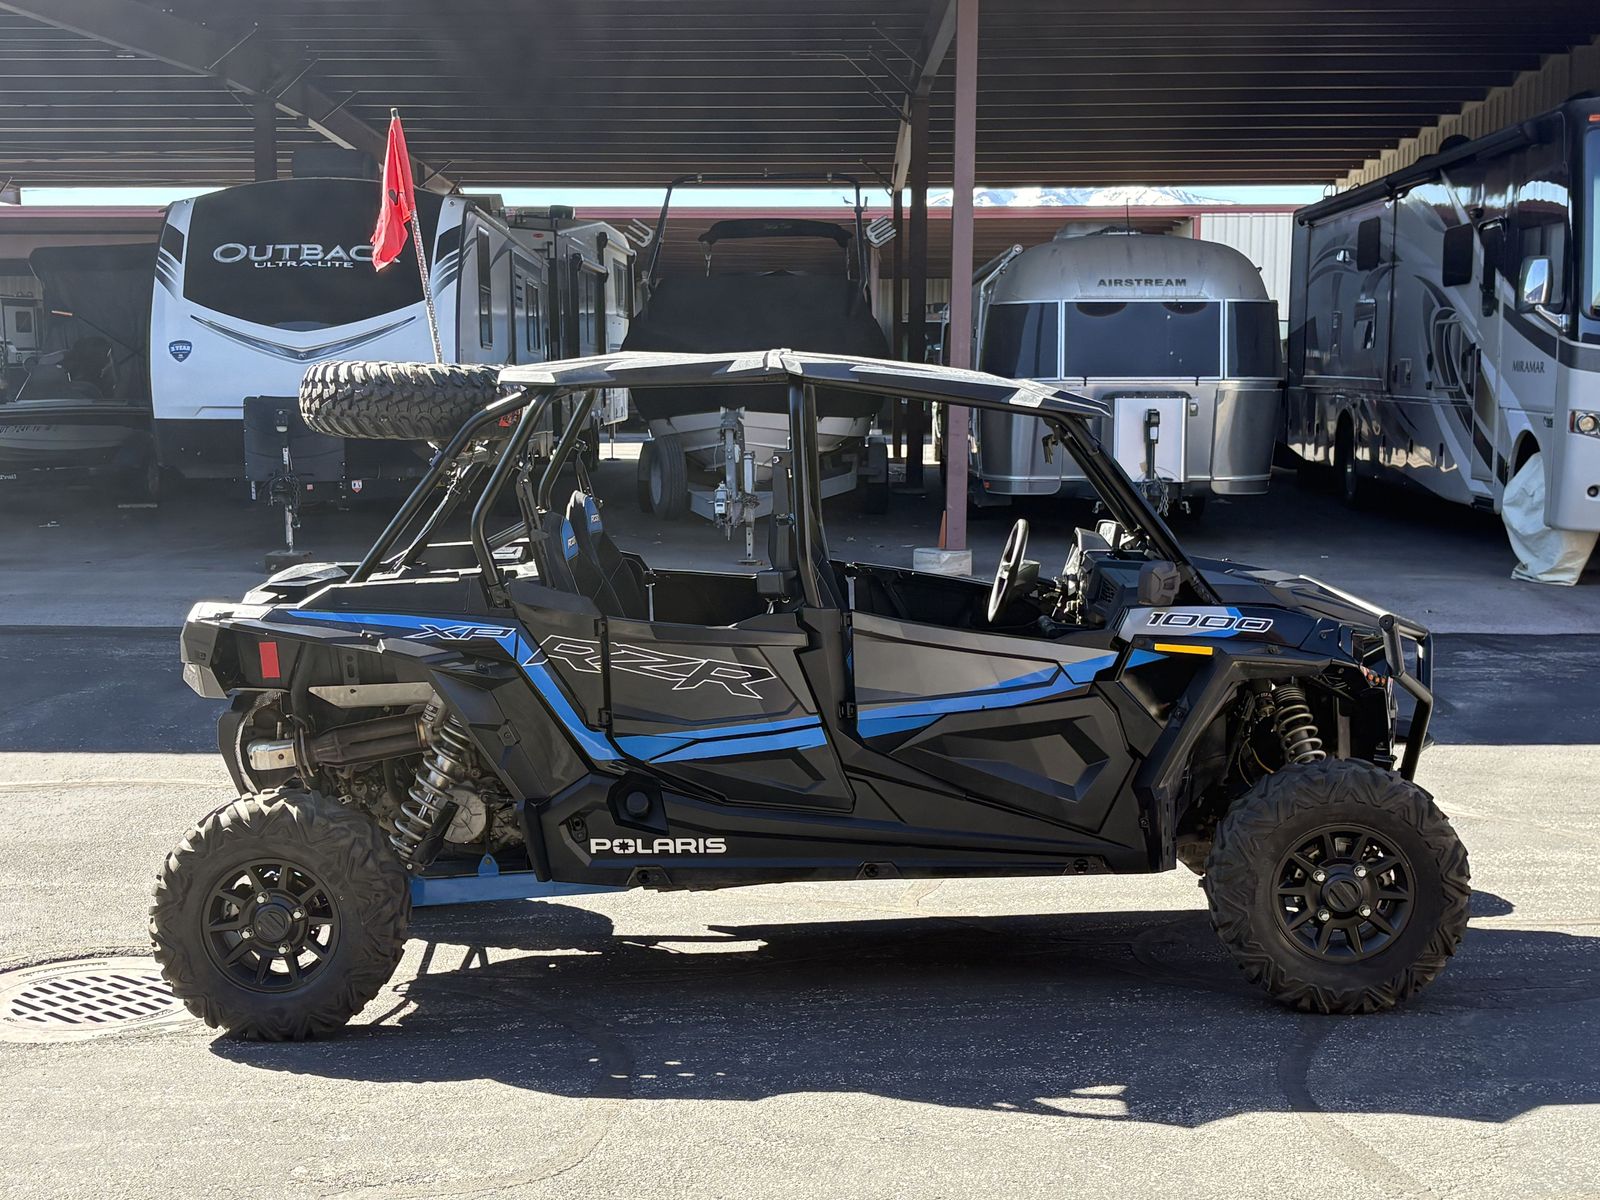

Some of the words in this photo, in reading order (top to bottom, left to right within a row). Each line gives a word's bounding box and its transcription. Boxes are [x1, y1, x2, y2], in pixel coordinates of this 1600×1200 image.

[213, 243, 400, 263] OUTBAC
[1097, 278, 1187, 287] AIRSTREAM
[1512, 361, 1545, 373] MIRAMAR
[1147, 611, 1273, 633] 1000
[402, 624, 517, 640] XP
[522, 634, 777, 699] RZR
[590, 837, 727, 854] POLARIS
